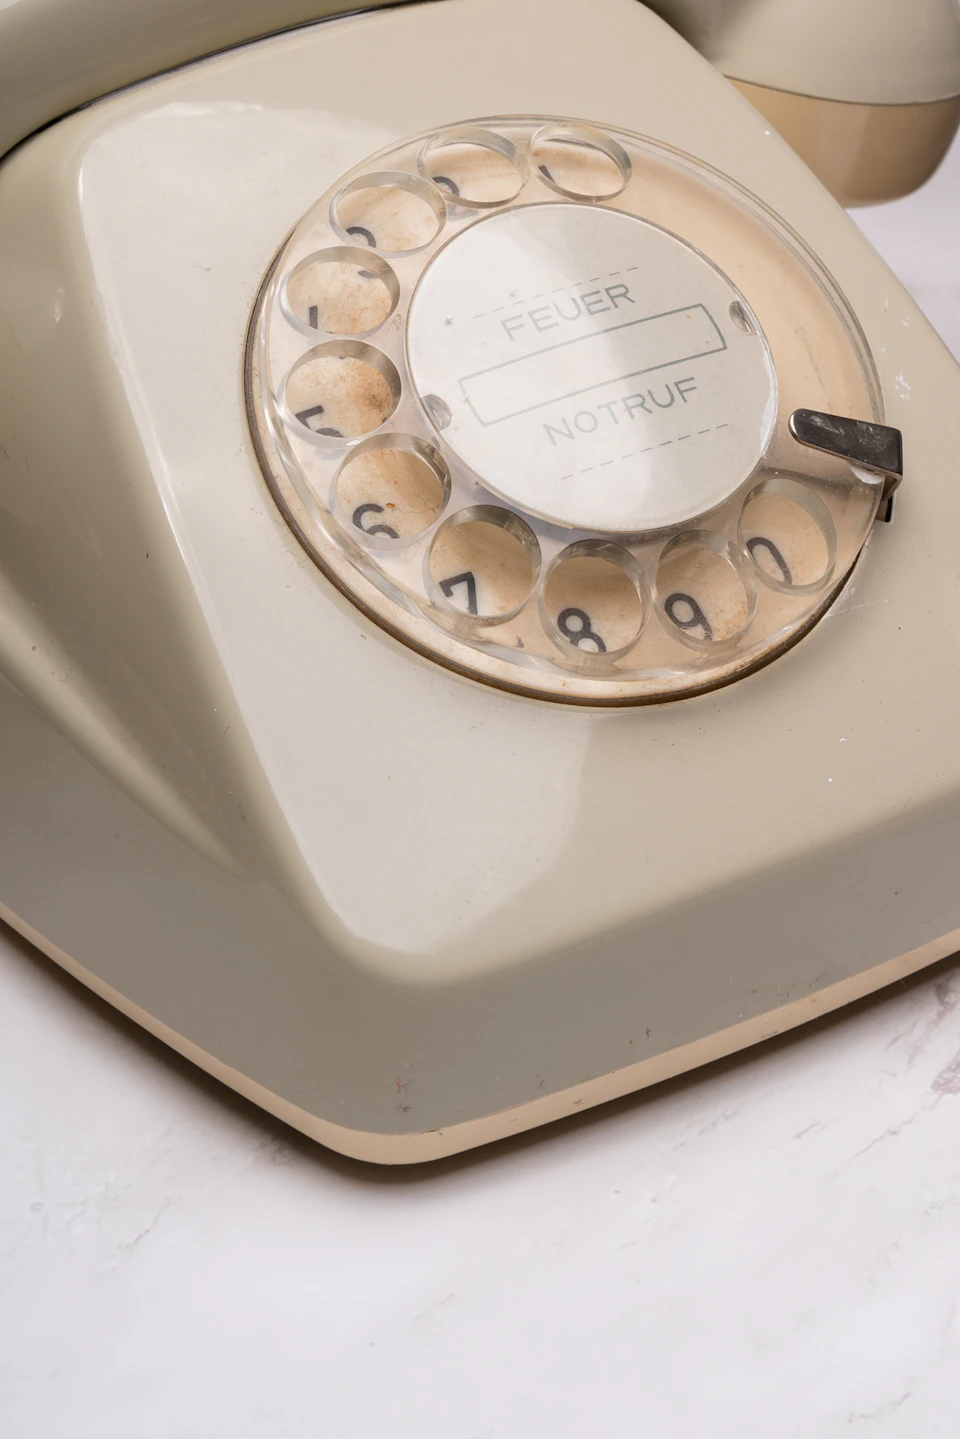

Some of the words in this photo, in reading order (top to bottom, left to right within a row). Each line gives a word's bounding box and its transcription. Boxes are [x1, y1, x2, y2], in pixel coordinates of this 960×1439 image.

[500, 284, 636, 342] FEUER
[542, 376, 697, 446] NOTRUF
[439, 571, 478, 615] 7
[664, 593, 712, 641] 9
[557, 608, 606, 653] 8
